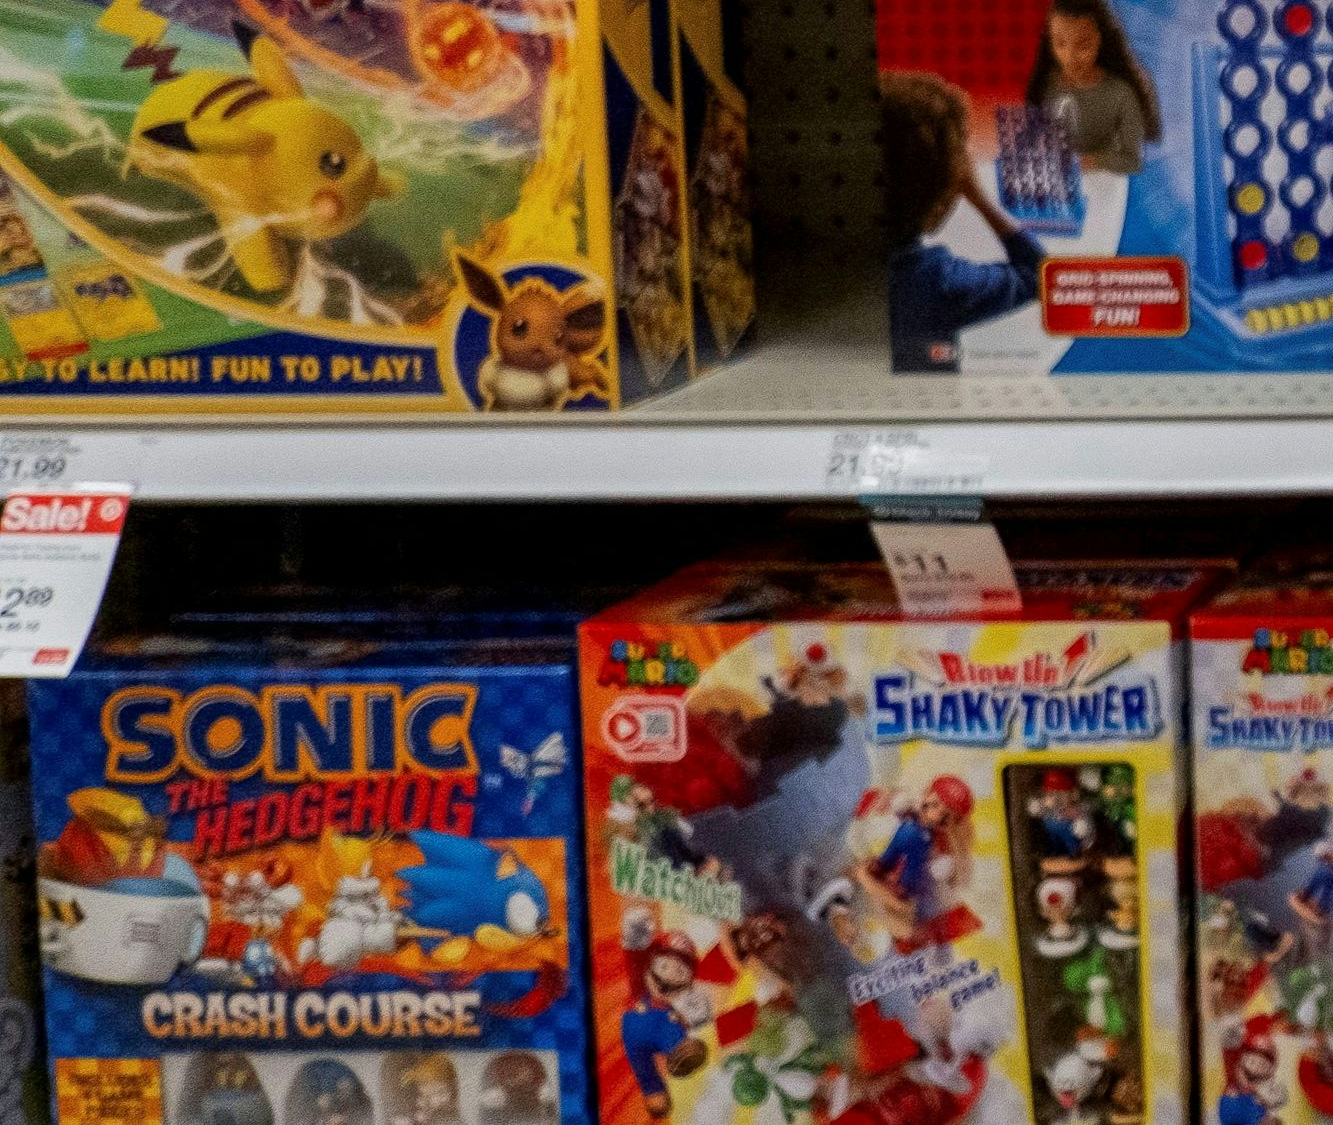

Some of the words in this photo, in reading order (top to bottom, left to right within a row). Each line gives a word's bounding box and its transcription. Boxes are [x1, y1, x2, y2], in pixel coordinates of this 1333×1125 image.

[1092, 305, 1141, 327] FUN!
[43, 357, 79, 383] TO
[88, 356, 200, 383] LEARN!
[209, 355, 272, 382] FUN
[281, 355, 321, 382] TO
[330, 355, 423, 382] PLAY!
[2, 496, 93, 532] Sale!
[103, 683, 478, 782] SONIC
[873, 675, 1015, 738] SHAKY
[1019, 681, 1150, 750] TOWER
[166, 775, 230, 814] THE
[191, 771, 480, 859] HEDGEHOG
[141, 991, 288, 1040] CRASH
[294, 990, 483, 1039] COURSE
